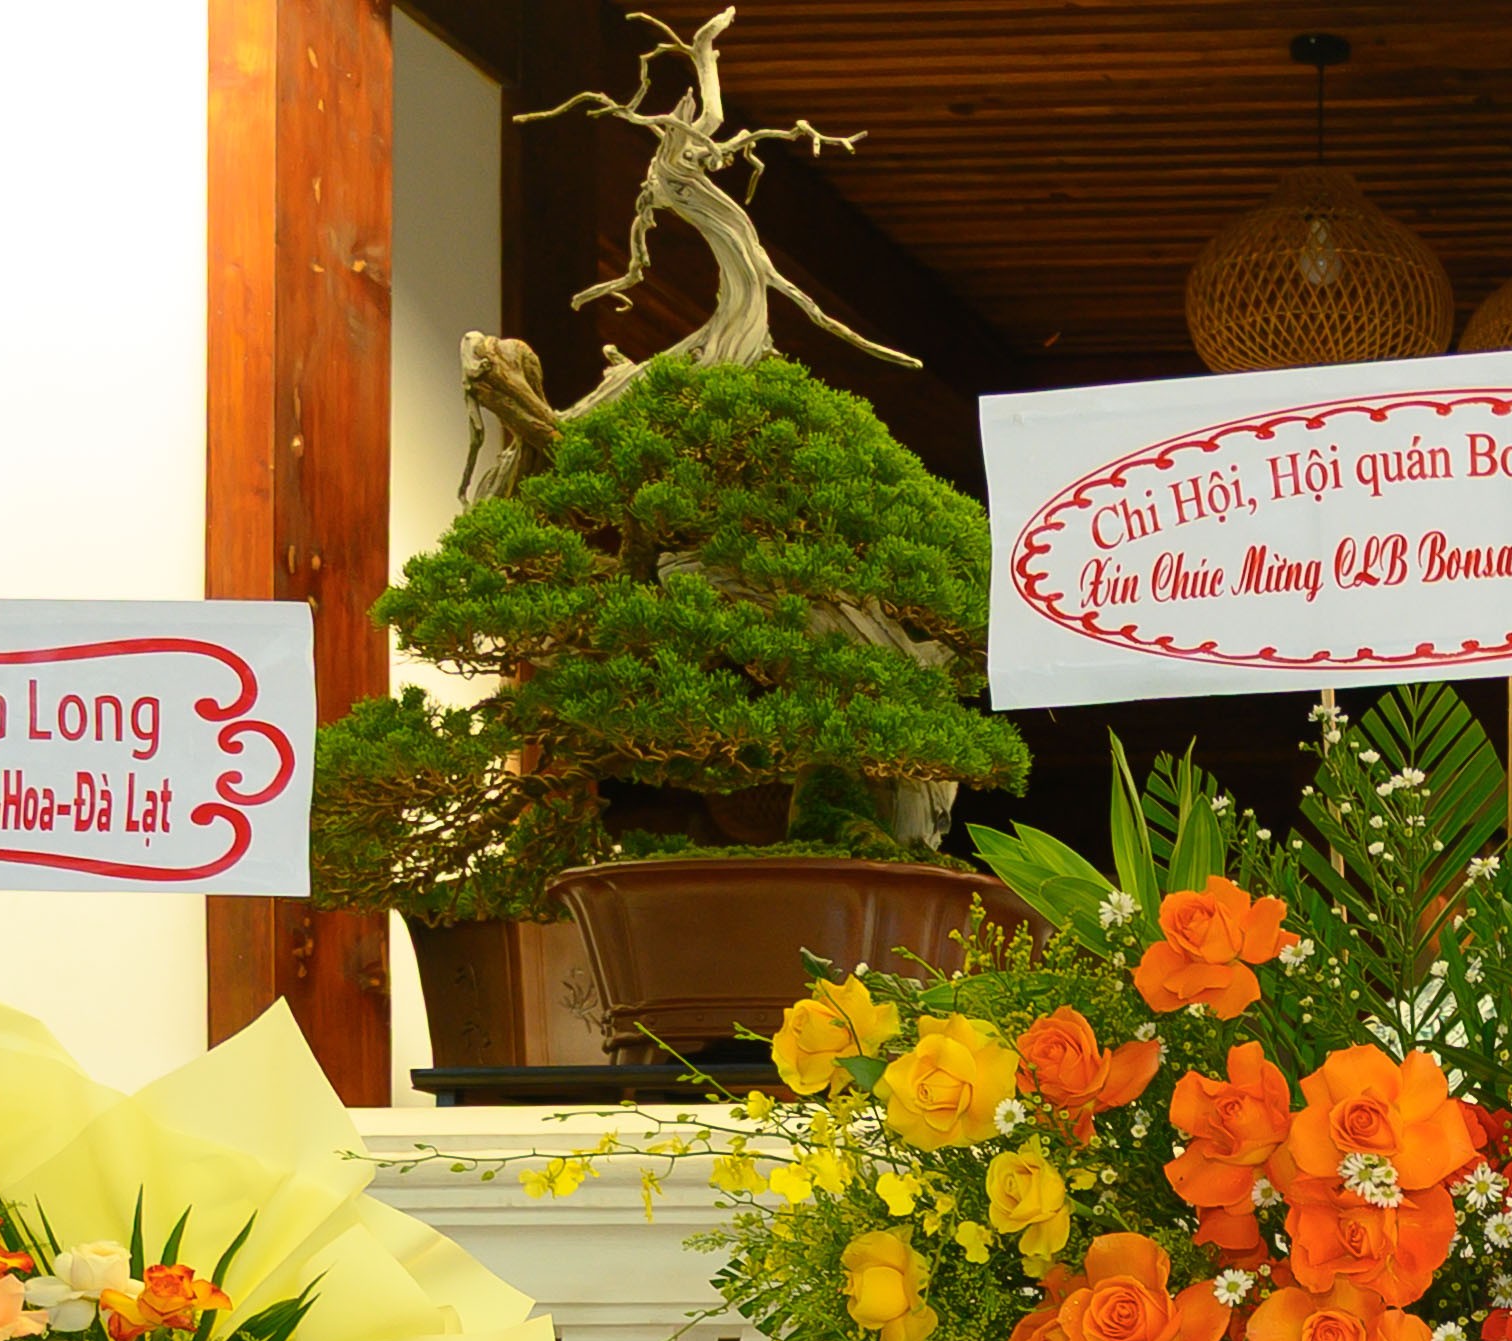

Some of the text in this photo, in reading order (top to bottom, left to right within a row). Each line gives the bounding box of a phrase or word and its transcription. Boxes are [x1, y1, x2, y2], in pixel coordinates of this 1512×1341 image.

[1091, 490, 1162, 550] Chi
[1170, 464, 1257, 525] Hội,
[1268, 449, 1342, 502] Hội
[1355, 435, 1453, 497] quán
[1080, 557, 1140, 608] Xin
[1151, 552, 1225, 603] Chúc
[1230, 545, 1324, 602] Mừng
[1333, 533, 1408, 589] CLB
[29, 679, 161, 760] Long
[125, 772, 173, 848] Lạt
